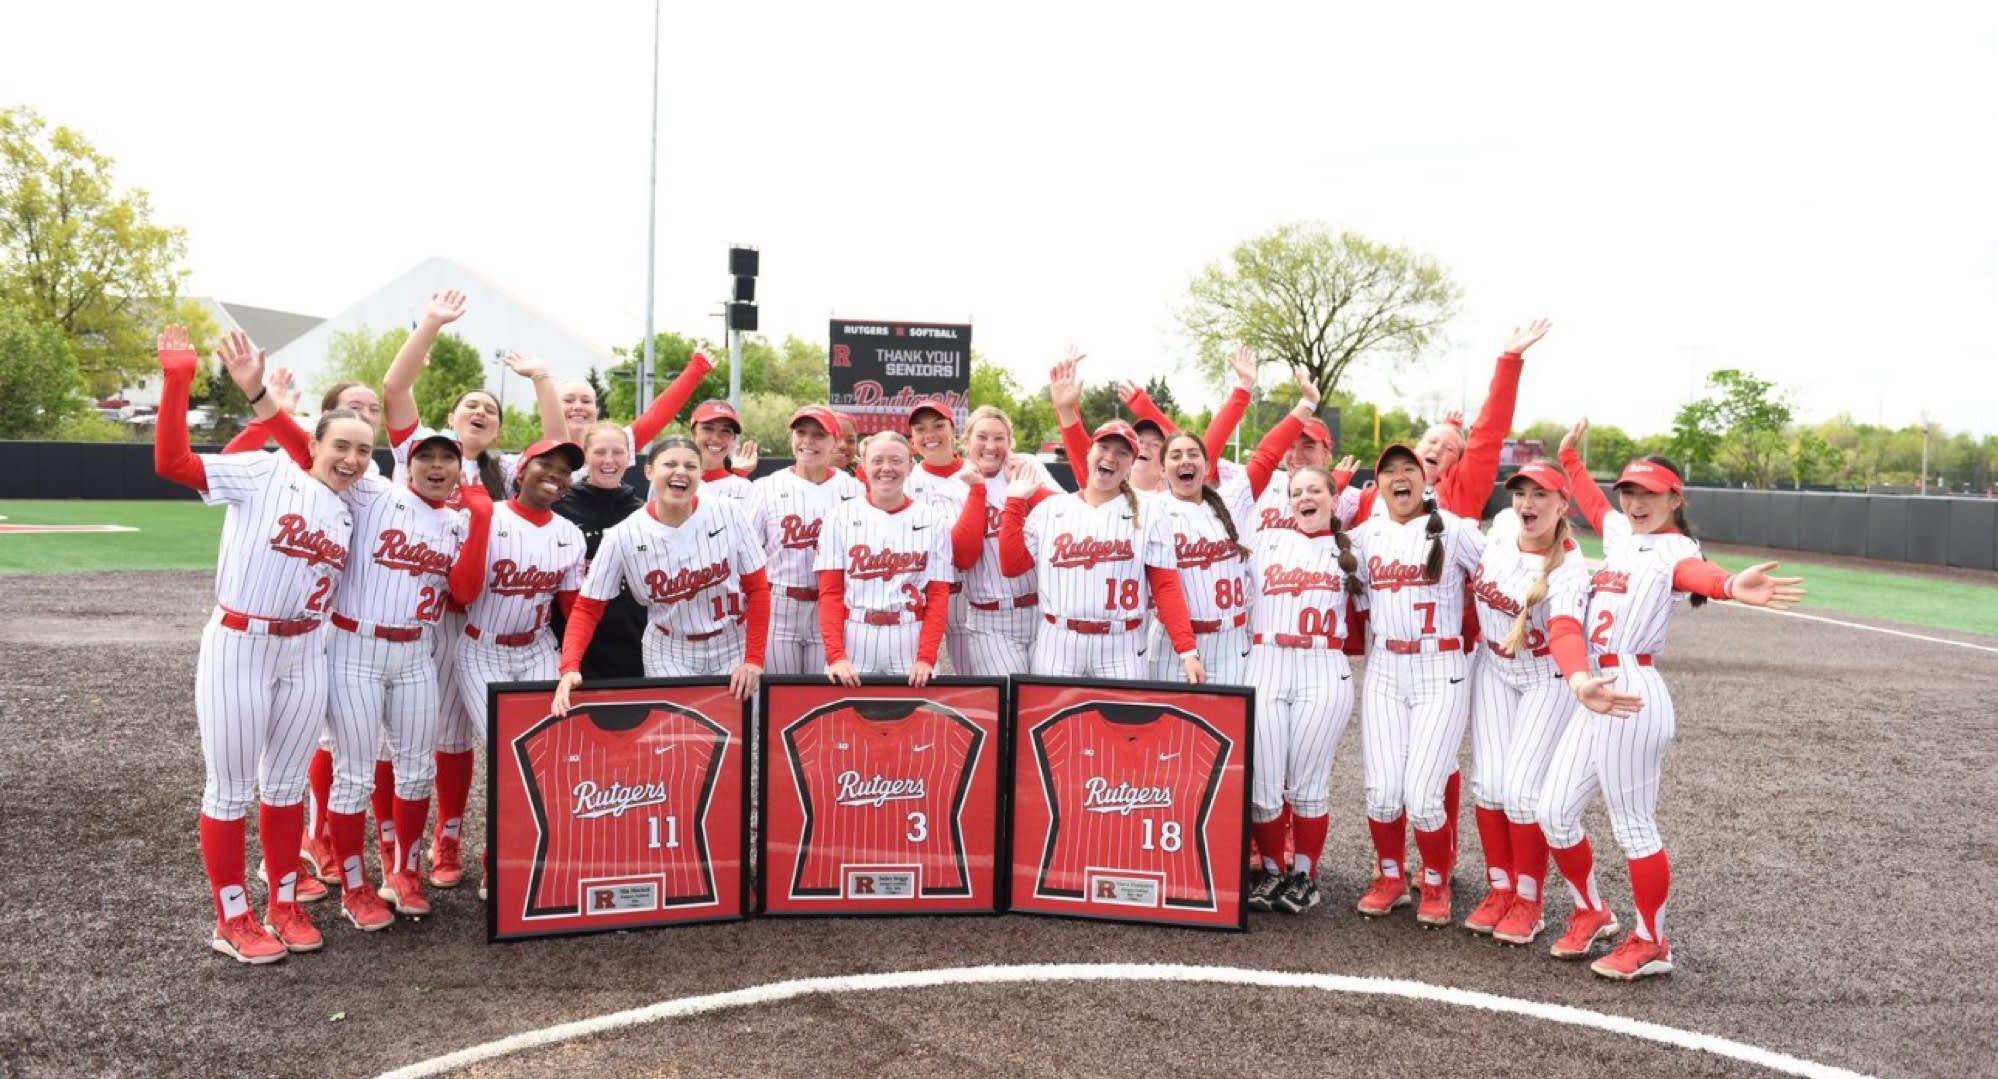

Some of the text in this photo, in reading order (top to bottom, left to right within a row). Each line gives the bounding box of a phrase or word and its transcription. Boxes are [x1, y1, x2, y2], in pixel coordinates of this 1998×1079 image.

[844, 325, 889, 335] RUTGERS
[909, 327, 957, 338] SOFTBALL
[833, 344, 852, 367] R
[876, 349, 953, 363] THANK YOU
[886, 363, 953, 377] SENIORS
[1050, 532, 1134, 570] Rutgers
[644, 558, 731, 604] Rutgers
[1105, 577, 1139, 611] 18
[1262, 564, 1341, 597] Rutgers
[711, 592, 742, 622] 11
[1414, 602, 1437, 634] 7
[572, 780, 667, 819] Rutgers
[836, 770, 925, 808] Rutgers
[1083, 776, 1172, 816] Rutgers
[648, 815, 679, 848] 11
[906, 811, 928, 843] 3
[1141, 818, 1182, 852] 18
[594, 890, 616, 909] R
[855, 876, 875, 894] R
[1096, 880, 1117, 898] R
